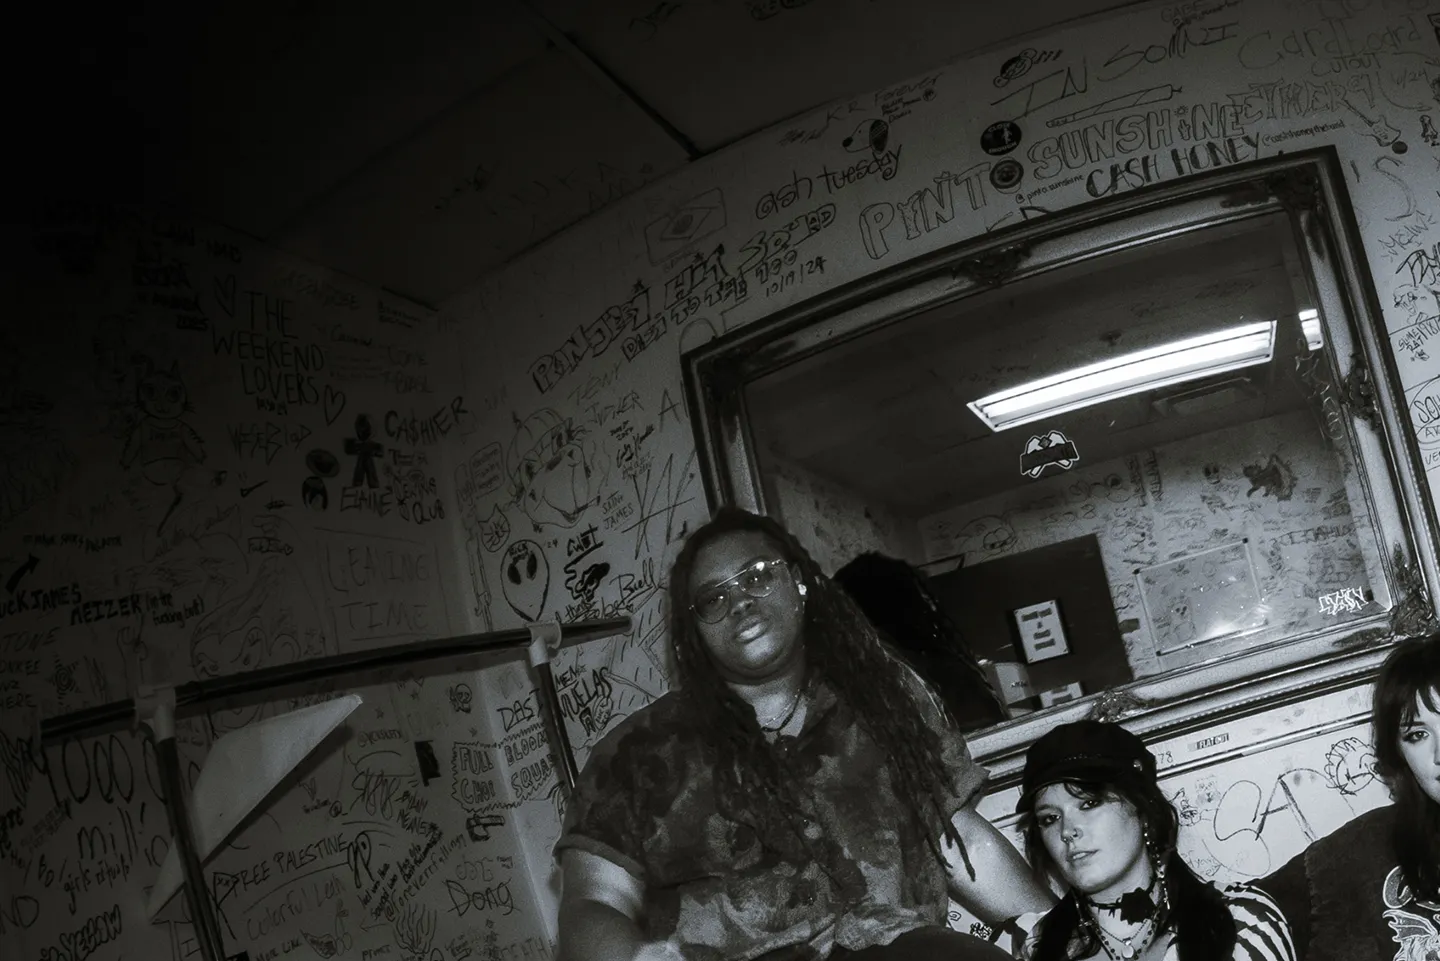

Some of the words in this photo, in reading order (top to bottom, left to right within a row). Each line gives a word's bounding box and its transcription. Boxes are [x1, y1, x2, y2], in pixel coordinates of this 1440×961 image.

[1086, 158, 1159, 198] CASH
[1171, 132, 1261, 176] HONEY
[243, 291, 298, 339] THE
[212, 329, 323, 373] WEEKEND
[241, 367, 320, 405] LOVERS
[233, 864, 270, 896] FREE
[272, 833, 349, 873] PALESTINE
